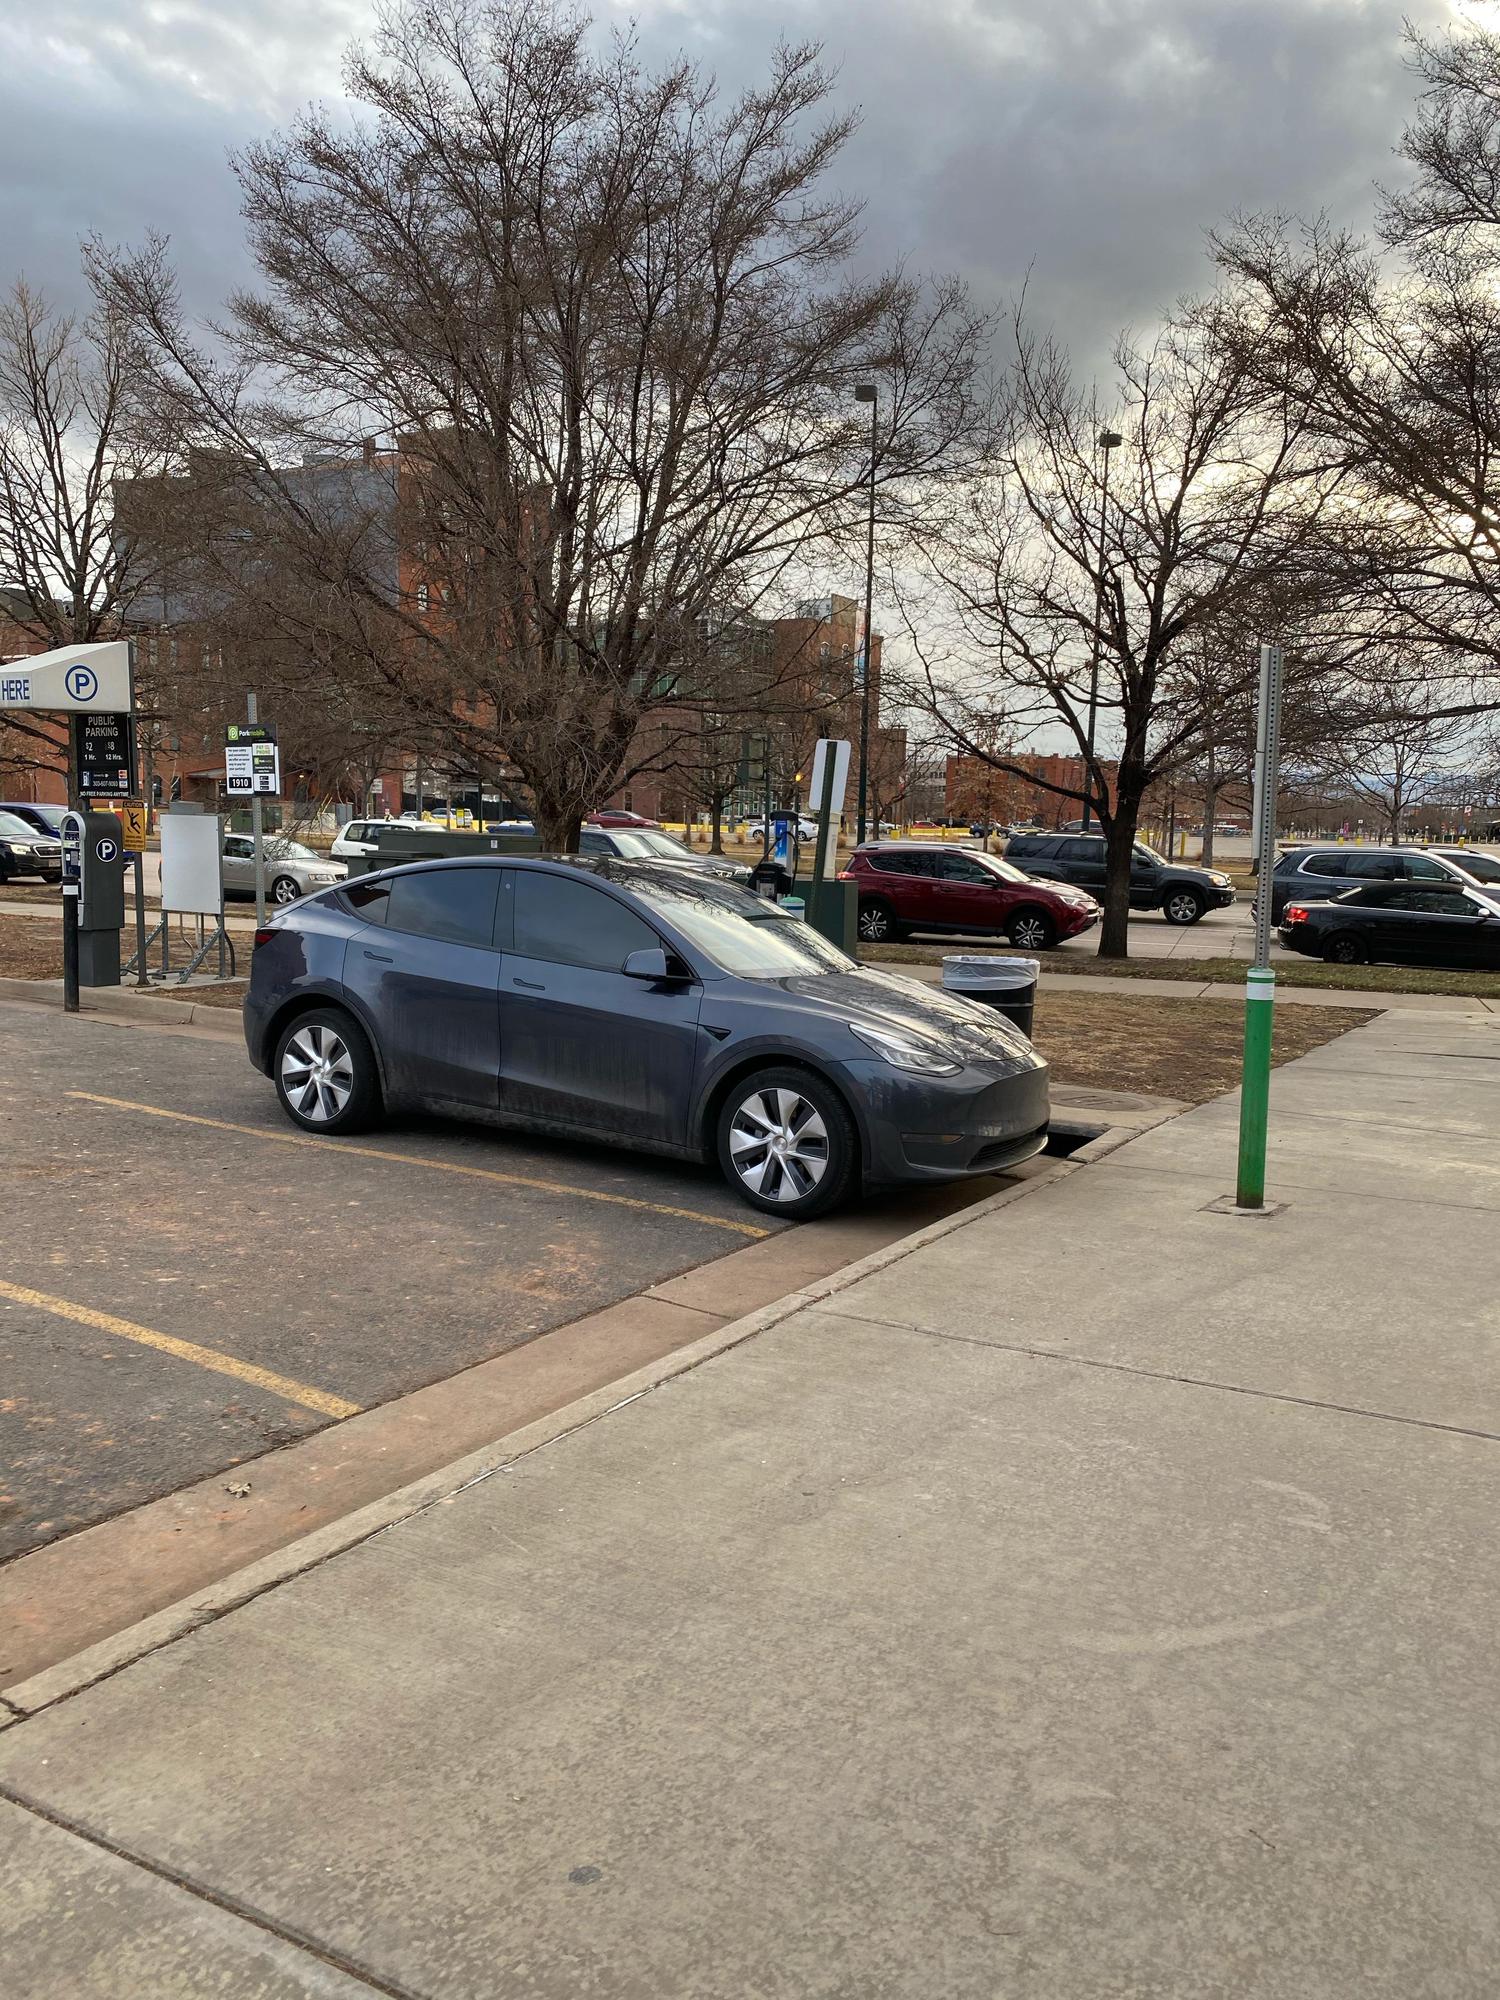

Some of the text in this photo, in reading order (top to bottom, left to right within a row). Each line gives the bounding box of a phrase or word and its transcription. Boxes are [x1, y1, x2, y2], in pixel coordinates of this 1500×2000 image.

[75, 673, 90, 694] P
[1, 679, 30, 701] HERE
[88, 716, 115, 726] PUBLIC
[85, 727, 119, 737] PARKING
[85, 742, 93, 752] $2
[107, 741, 115, 751] $8
[232, 778, 249, 787] 1910
[101, 842, 113, 858] P
